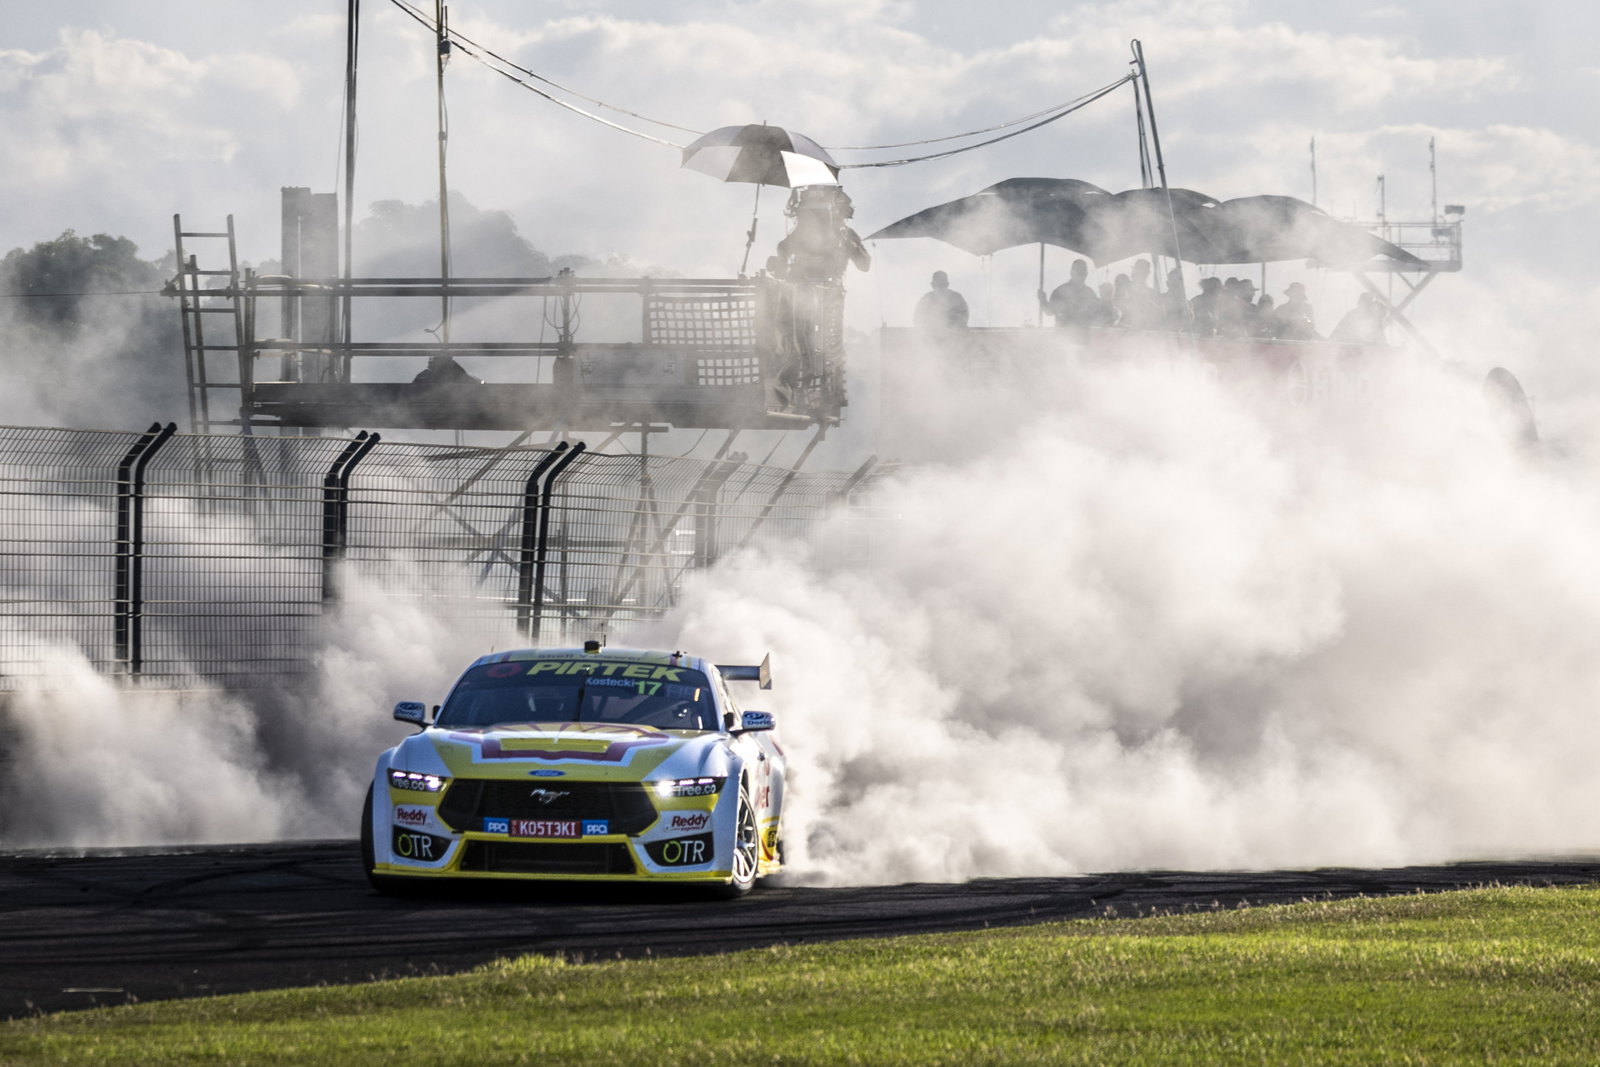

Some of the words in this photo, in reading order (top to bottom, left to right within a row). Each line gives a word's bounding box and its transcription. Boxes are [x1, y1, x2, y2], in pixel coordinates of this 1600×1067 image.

[527, 662, 685, 682] PIRTEK
[586, 676, 635, 688] Kostecki
[635, 680, 663, 696] 17
[397, 807, 428, 825] Reddy
[671, 813, 711, 830] Reddy
[488, 822, 509, 833] PPQ
[586, 824, 608, 834] PPQ
[398, 833, 433, 858] OTR
[663, 839, 706, 863] OTR
